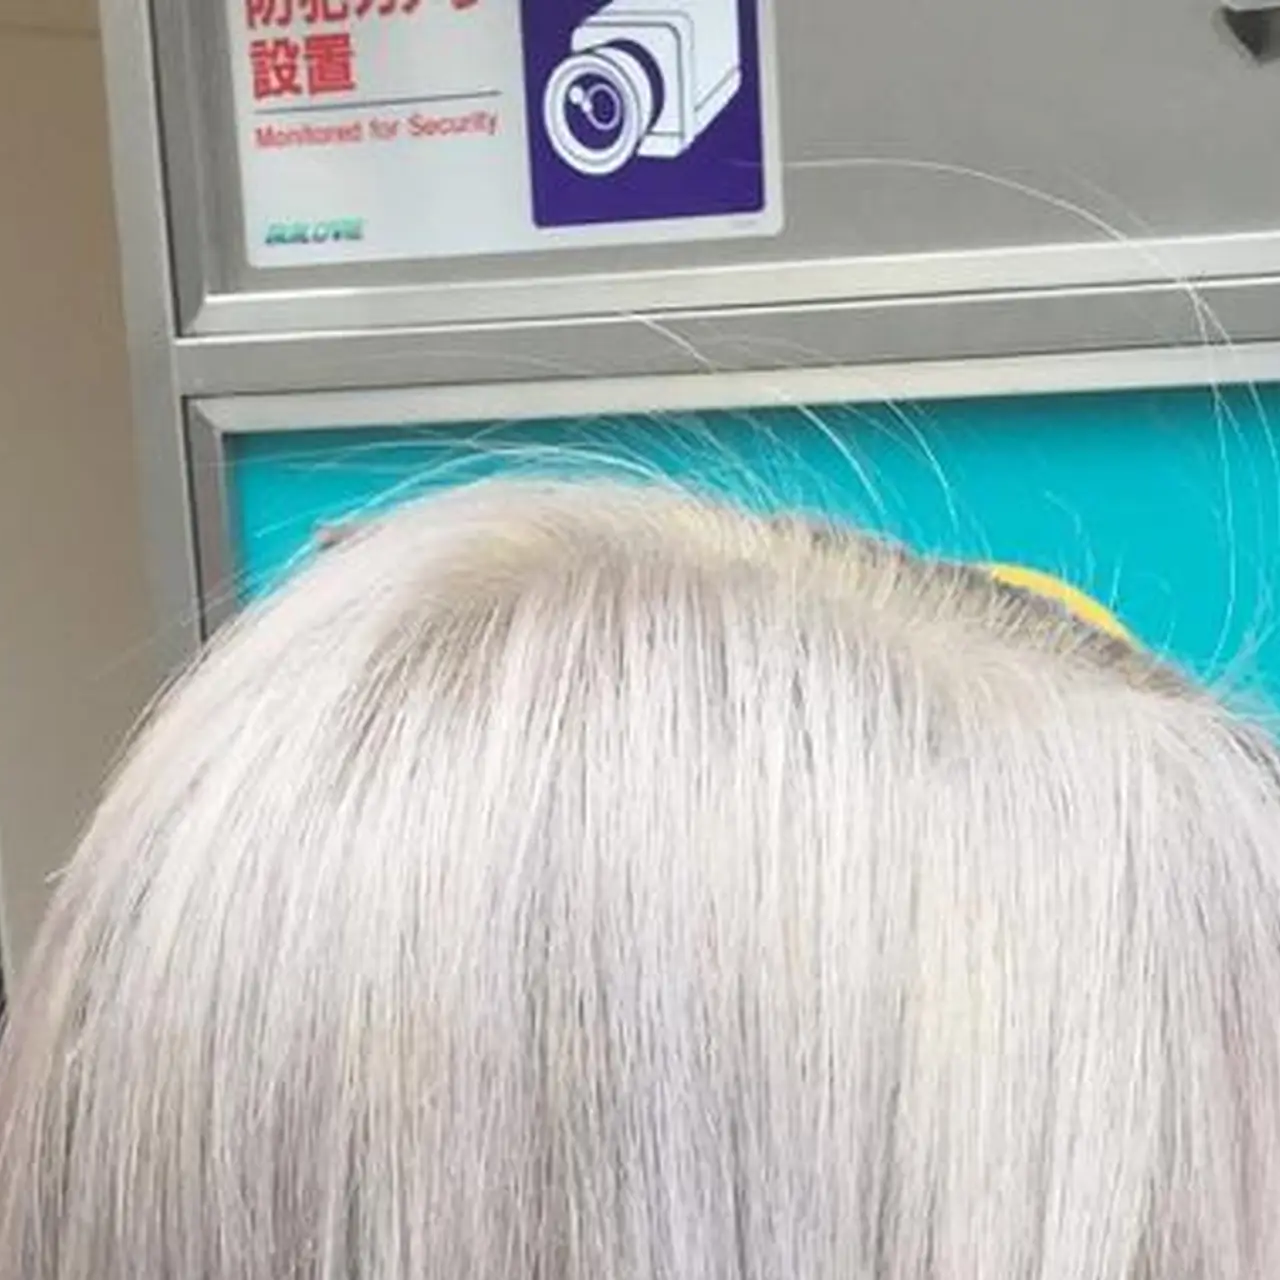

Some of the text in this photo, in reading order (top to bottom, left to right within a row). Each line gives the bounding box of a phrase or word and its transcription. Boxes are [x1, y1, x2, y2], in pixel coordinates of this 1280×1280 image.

[249, 33, 356, 99] 設置
[254, 111, 498, 148] Monitored for Security
